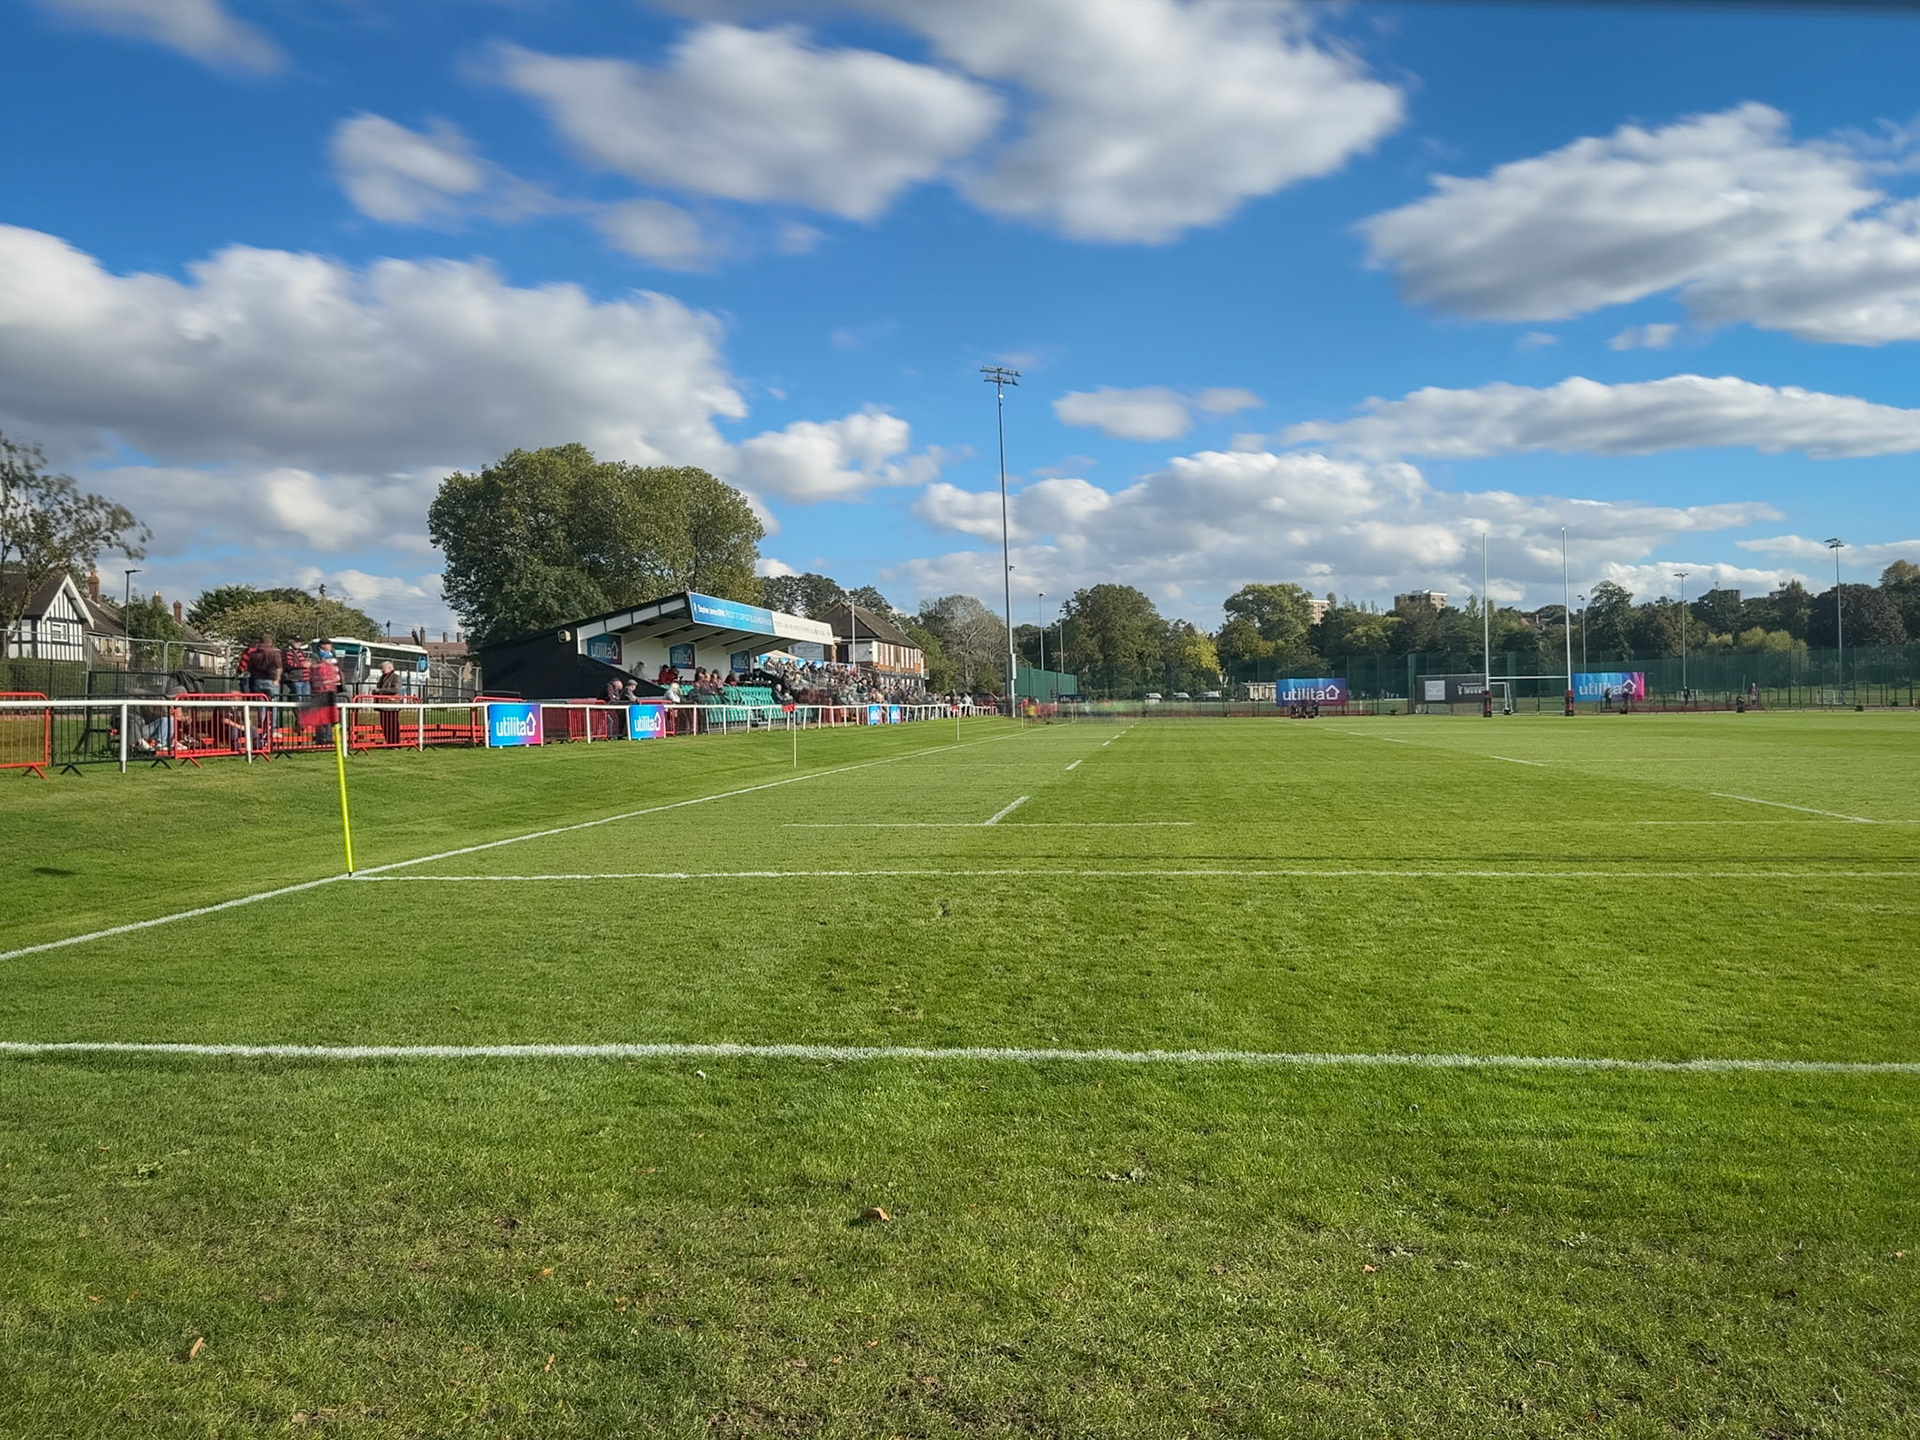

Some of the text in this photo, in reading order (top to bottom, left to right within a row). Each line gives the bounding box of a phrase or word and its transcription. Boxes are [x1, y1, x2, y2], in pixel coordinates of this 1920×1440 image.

[591, 643, 611, 659] utilita
[1282, 687, 1325, 701] utilita
[496, 716, 527, 737] utilita
[635, 715, 655, 731] utilita
